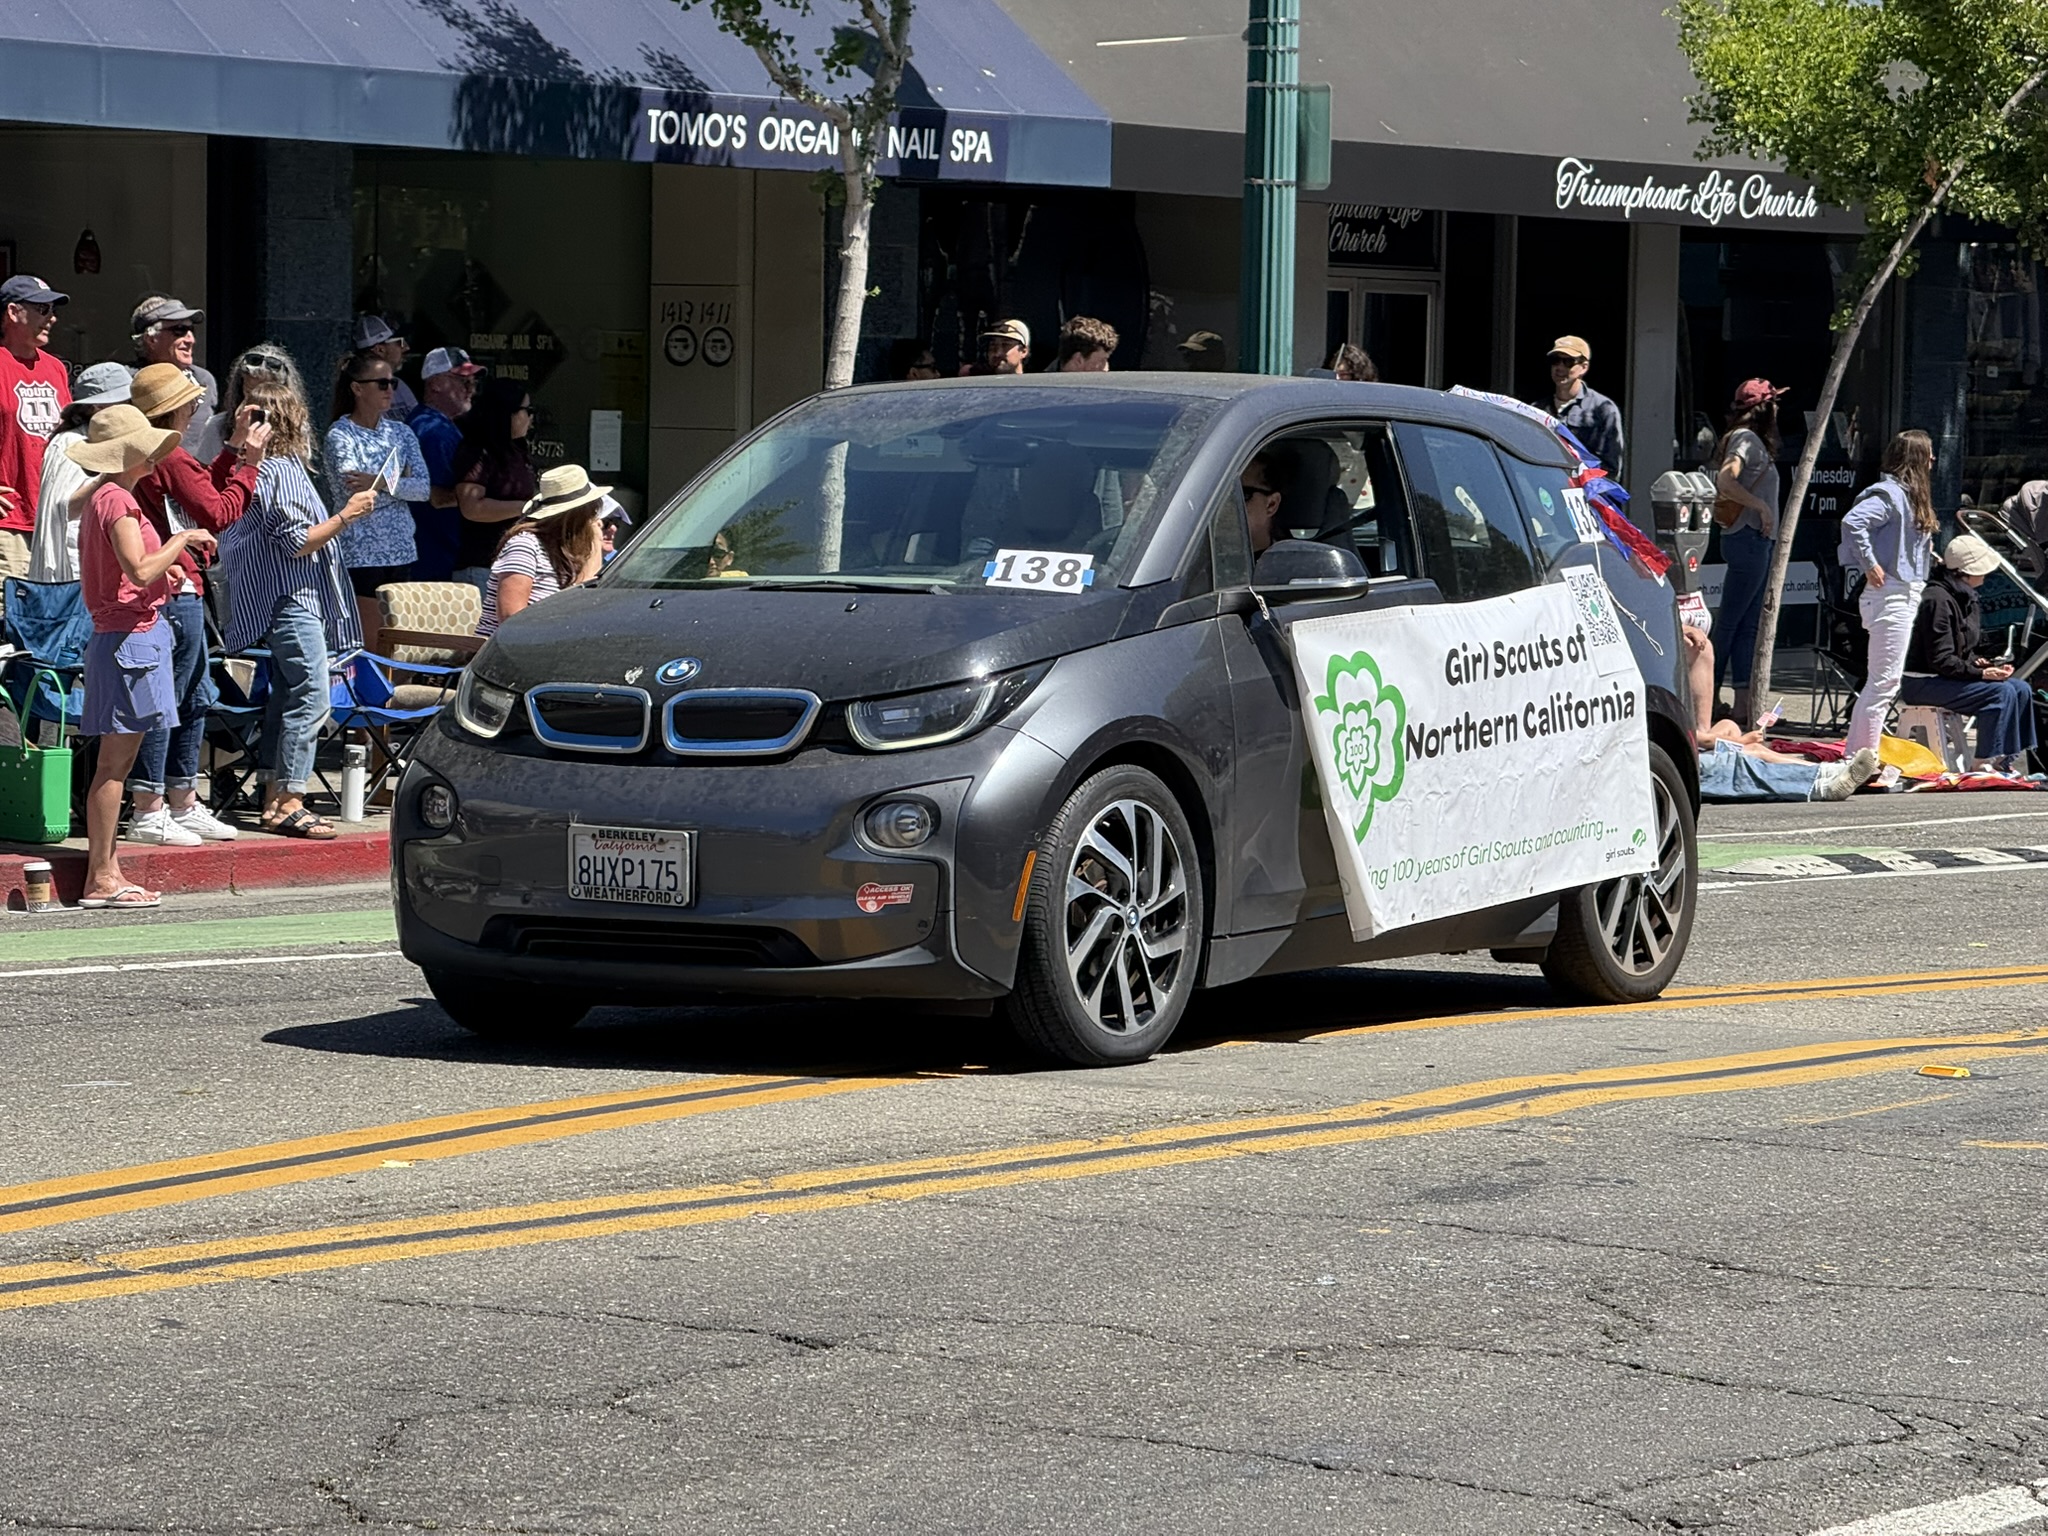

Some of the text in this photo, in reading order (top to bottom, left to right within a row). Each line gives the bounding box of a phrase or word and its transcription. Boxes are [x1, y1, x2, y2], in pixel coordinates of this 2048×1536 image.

[647, 108, 747, 150] TOMO'S
[887, 125, 940, 160] NAIL
[950, 128, 993, 164] SPA
[1555, 156, 1820, 226] Triumphant Life Church
[1329, 221, 1388, 254] Church
[699, 302, 732, 325] 1411
[18, 387, 55, 398] ROUTE
[27, 401, 52, 417] 11
[1809, 492, 1837, 515] 7 pm
[994, 554, 1082, 588] 138
[1445, 622, 1588, 687] Girl Scouts of
[1405, 680, 1636, 763] Northern California
[593, 839, 665, 856] California
[598, 829, 656, 842] BERKELEY
[1392, 857, 1415, 883] 100
[1414, 854, 1452, 884] years
[1452, 845, 1468, 870] of
[1468, 841, 1493, 867] Girl
[1493, 835, 1534, 863] Scouts
[1534, 827, 1555, 852] and
[1553, 817, 1605, 846] counting
[578, 855, 678, 892] 8HXP175
[583, 886, 672, 904] WEATHERFORD
